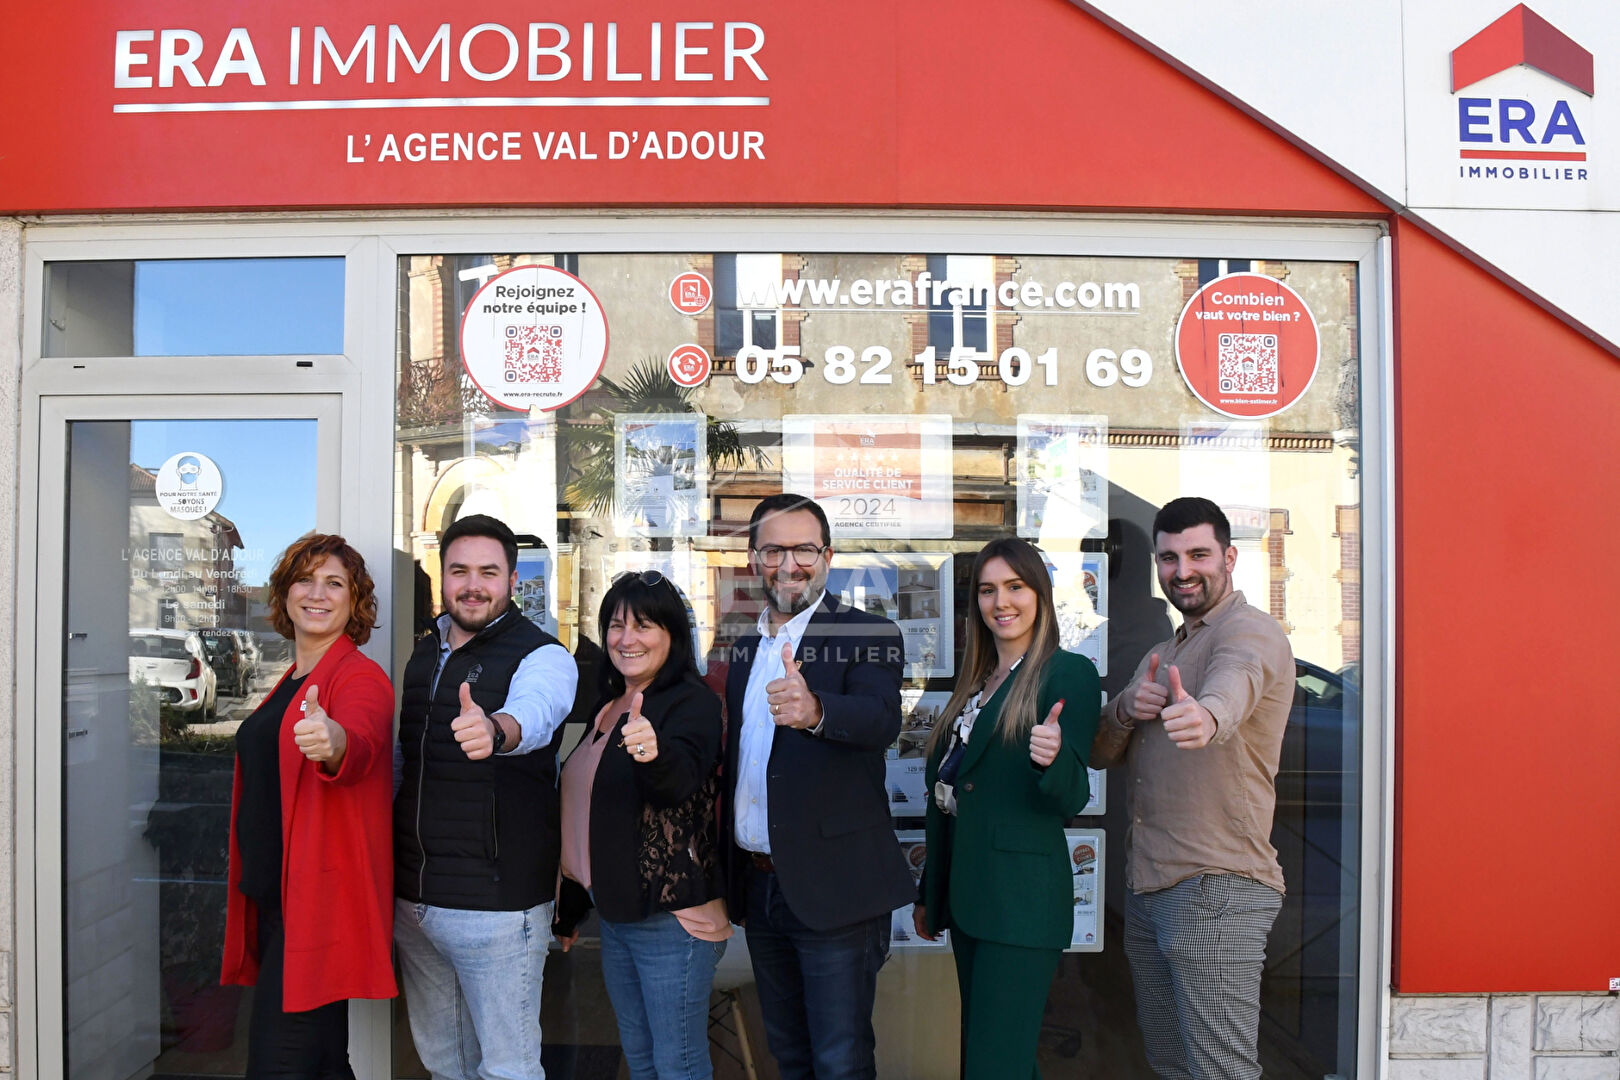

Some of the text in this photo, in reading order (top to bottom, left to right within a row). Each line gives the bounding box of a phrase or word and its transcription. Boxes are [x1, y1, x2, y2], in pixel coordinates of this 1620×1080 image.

[114, 21, 769, 88] ERA IMMOBILIER
[1458, 97, 1586, 145] ERA
[532, 131, 598, 161] VAL
[608, 130, 766, 160] D'ADOUR
[1460, 166, 1588, 180] IMMOBILIER
[496, 285, 574, 299] Rejoignez
[737, 272, 1141, 309] www.erafrance.com
[1211, 292, 1284, 306] Combien
[483, 300, 586, 316] notre équipe !
[1195, 310, 1301, 322] vaut votre bien ?
[736, 345, 1154, 388] 05 82 15 01 69
[834, 466, 901, 478] QUALITÉ DE
[822, 479, 913, 489] SERVICE CLIENT
[839, 498, 896, 516] 2024
[186, 549, 207, 561] VAL
[211, 549, 264, 561] D'ADOUR
[188, 570, 202, 579] au
[226, 584, 252, 593] 18h30
[183, 599, 225, 610] samedi
